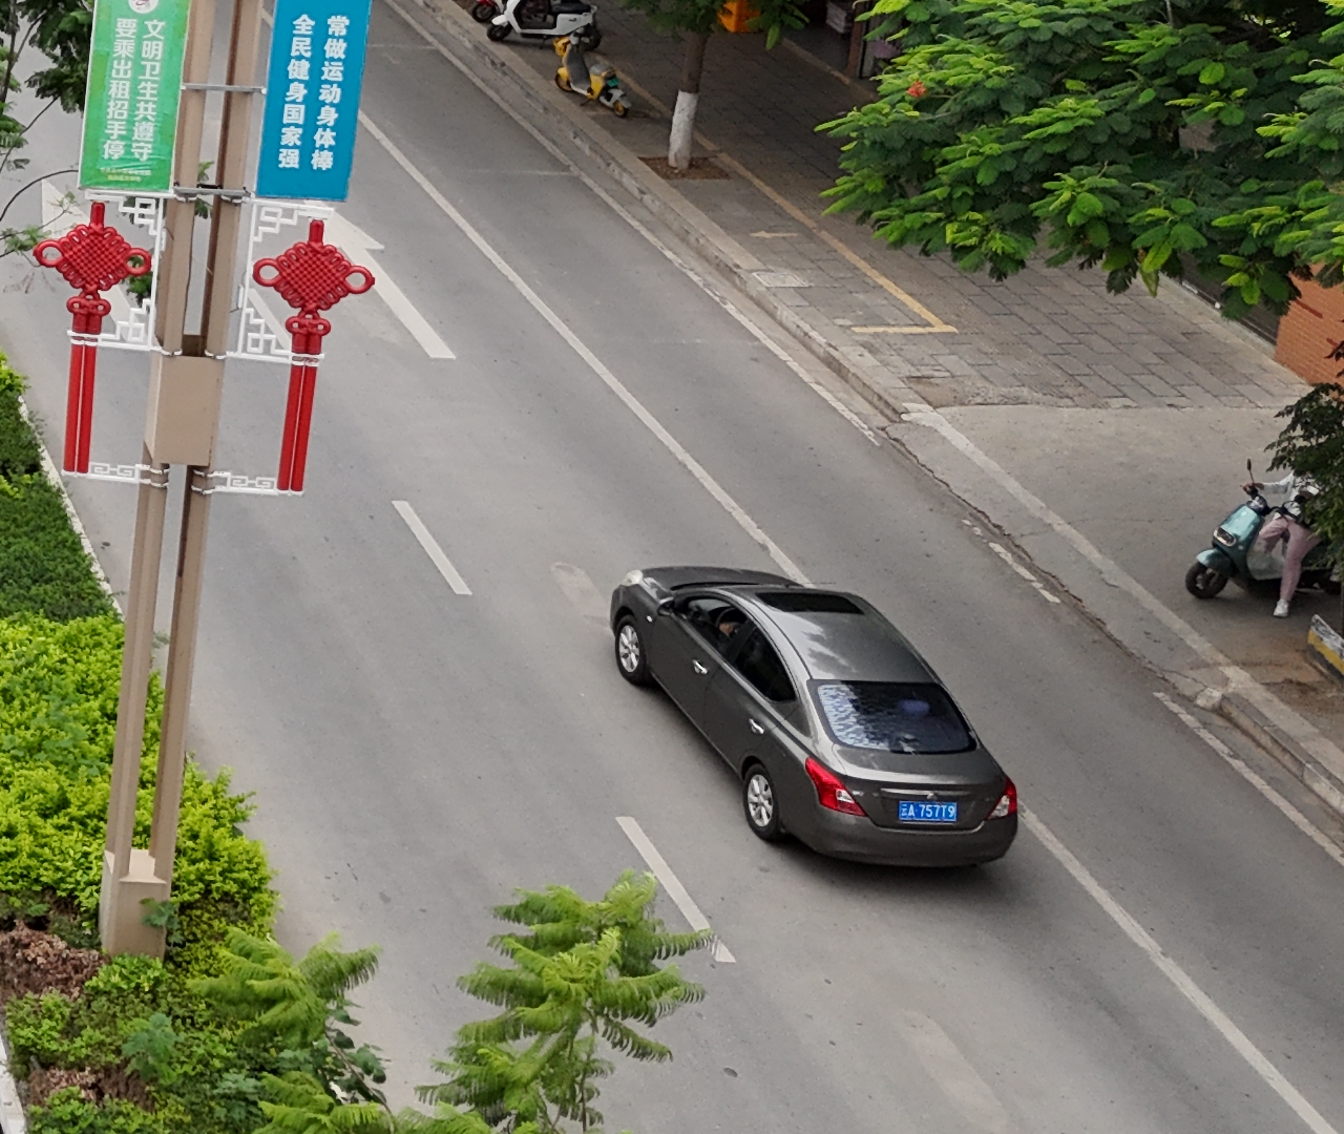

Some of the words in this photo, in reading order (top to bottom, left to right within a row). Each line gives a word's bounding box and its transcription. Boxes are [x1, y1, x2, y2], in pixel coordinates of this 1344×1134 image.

[103, 18, 138, 160] 要乘出租招手停
[131, 19, 166, 162] 文明卫生共遵守
[278, 14, 315, 169] 全民健身国家强
[311, 15, 350, 170] 常做运动身体棒
